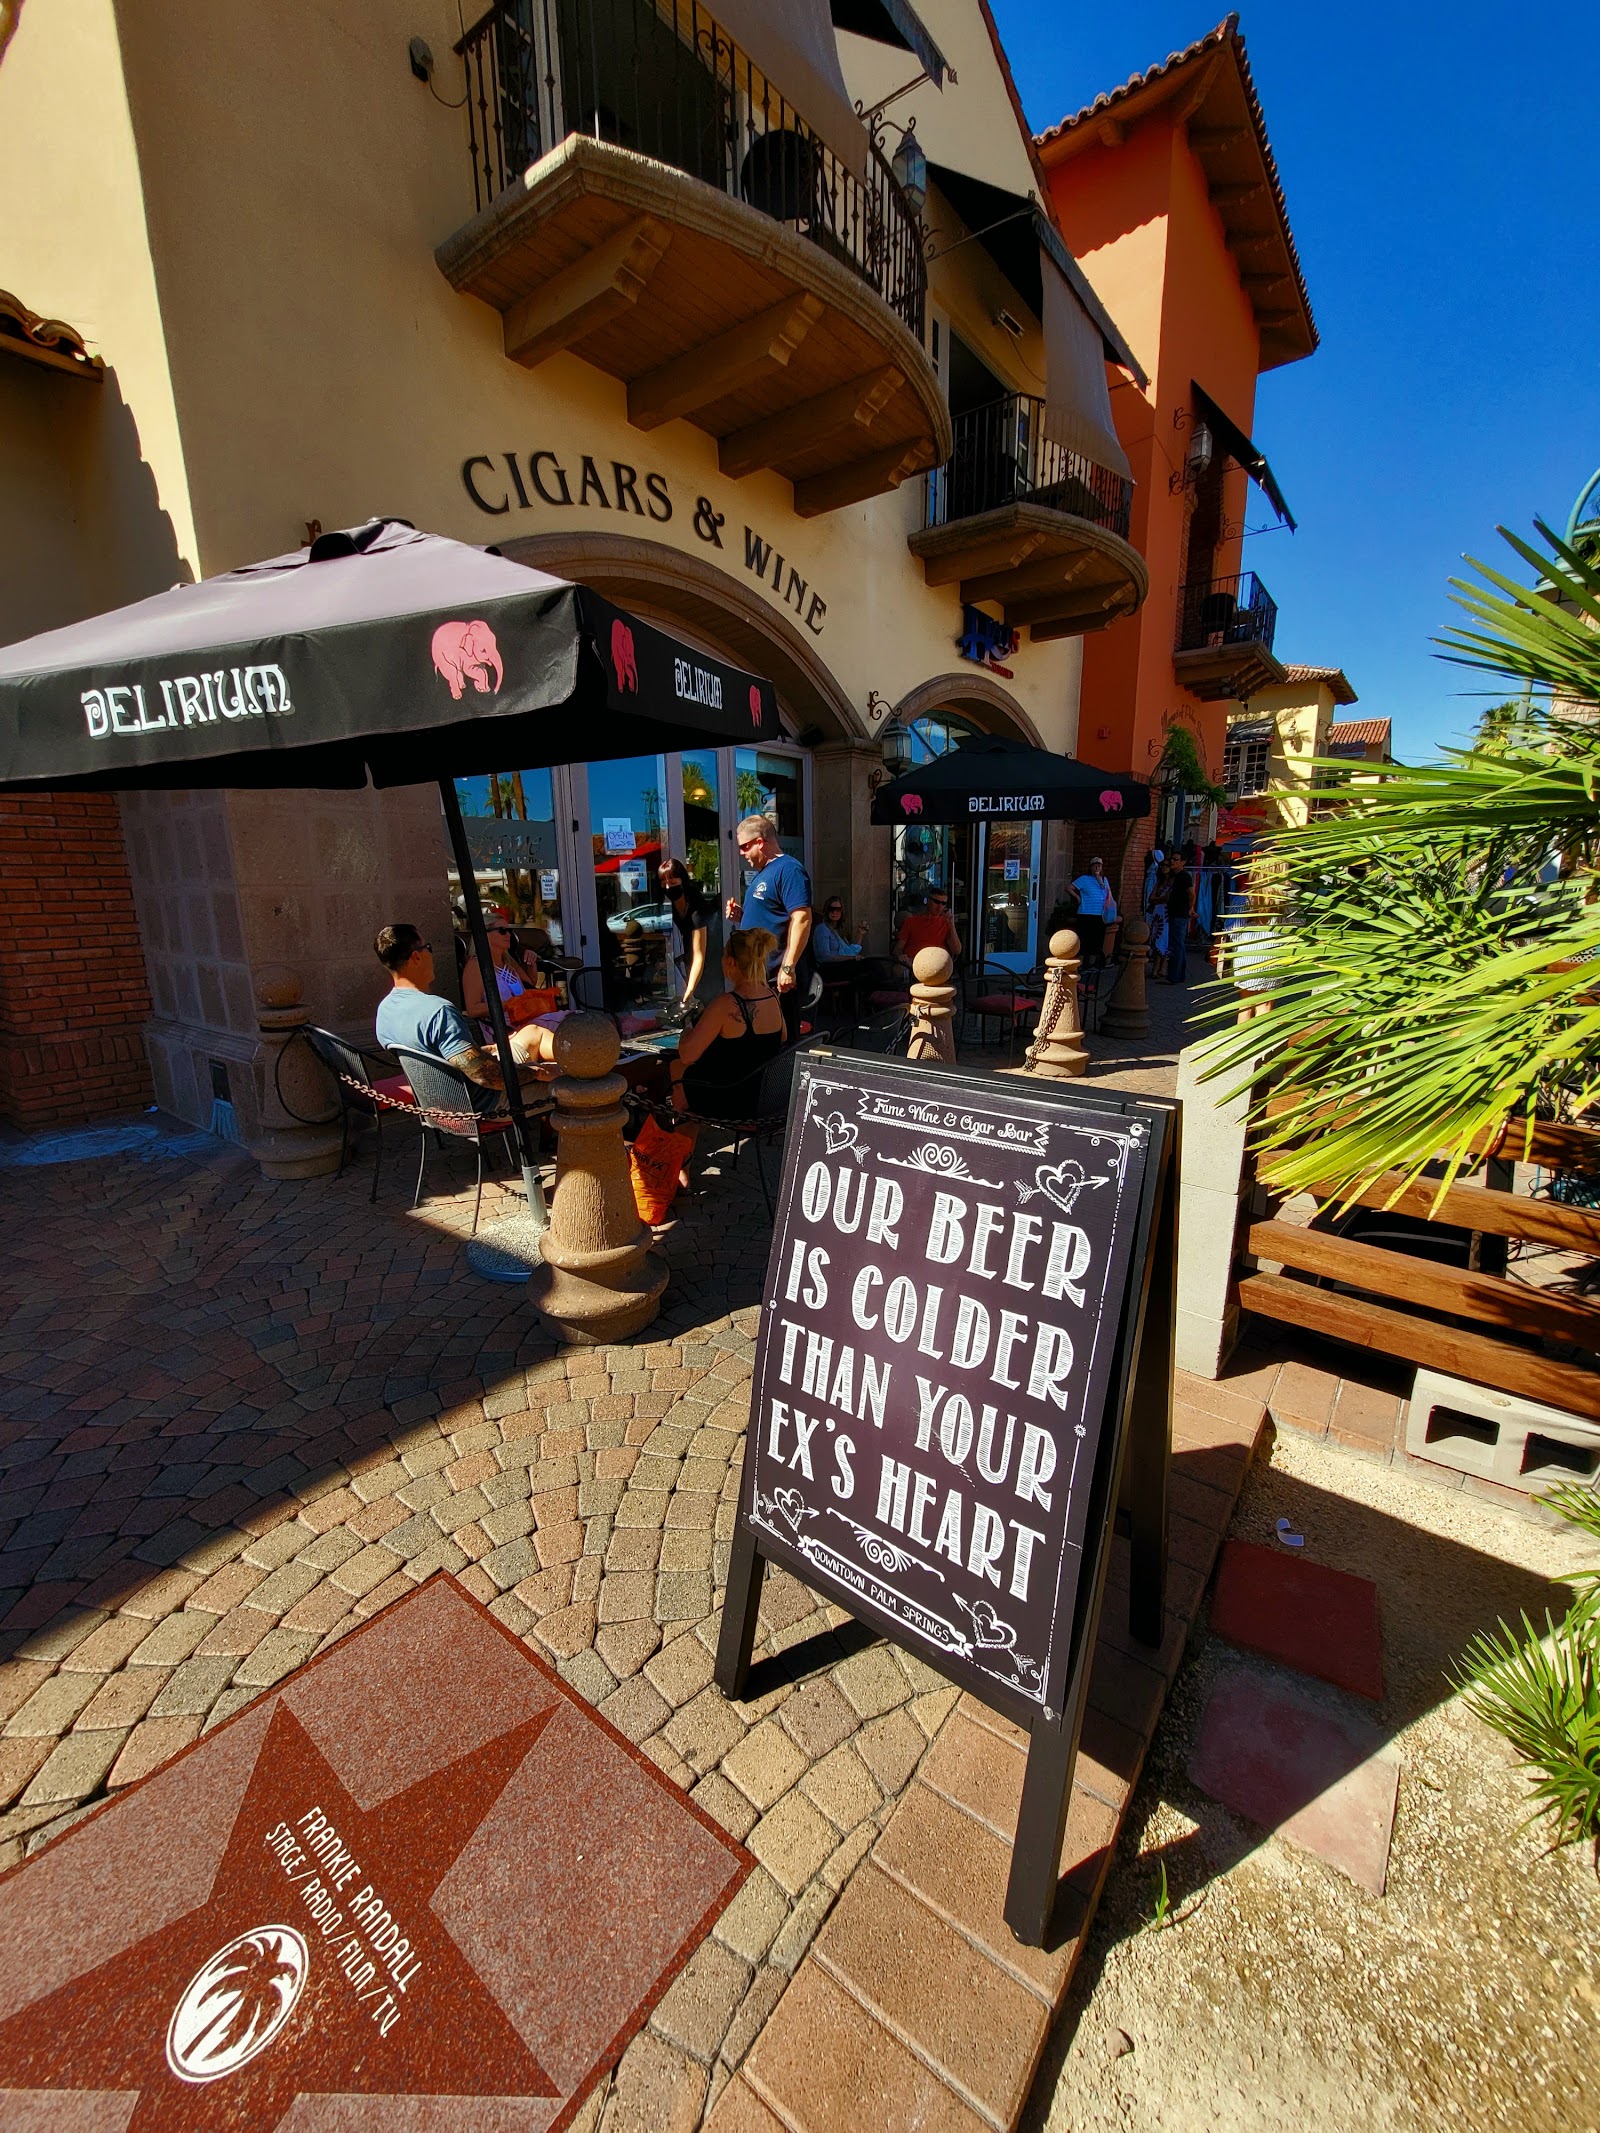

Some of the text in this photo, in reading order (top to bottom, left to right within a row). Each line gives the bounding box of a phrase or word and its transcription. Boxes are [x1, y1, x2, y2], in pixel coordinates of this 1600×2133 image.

[461, 451, 828, 637] CIGARS & WINE
[81, 663, 292, 739] DELIRIUM
[674, 657, 723, 710] DELIRIUM
[968, 795, 1046, 813] DELIRIUM
[873, 1098, 1033, 1142] Fame Wine & Cigar Bar
[801, 1161, 1092, 1309] OUR BEER
[784, 1238, 1075, 1412] IS COLDER
[778, 1318, 1058, 1513] THAN YOUR
[767, 1398, 1046, 1603] EX'S HEART
[814, 1549, 950, 1642] DOWNTOWN PALM SPRINGS
[297, 1805, 422, 1994] FRANKIE RANDALL
